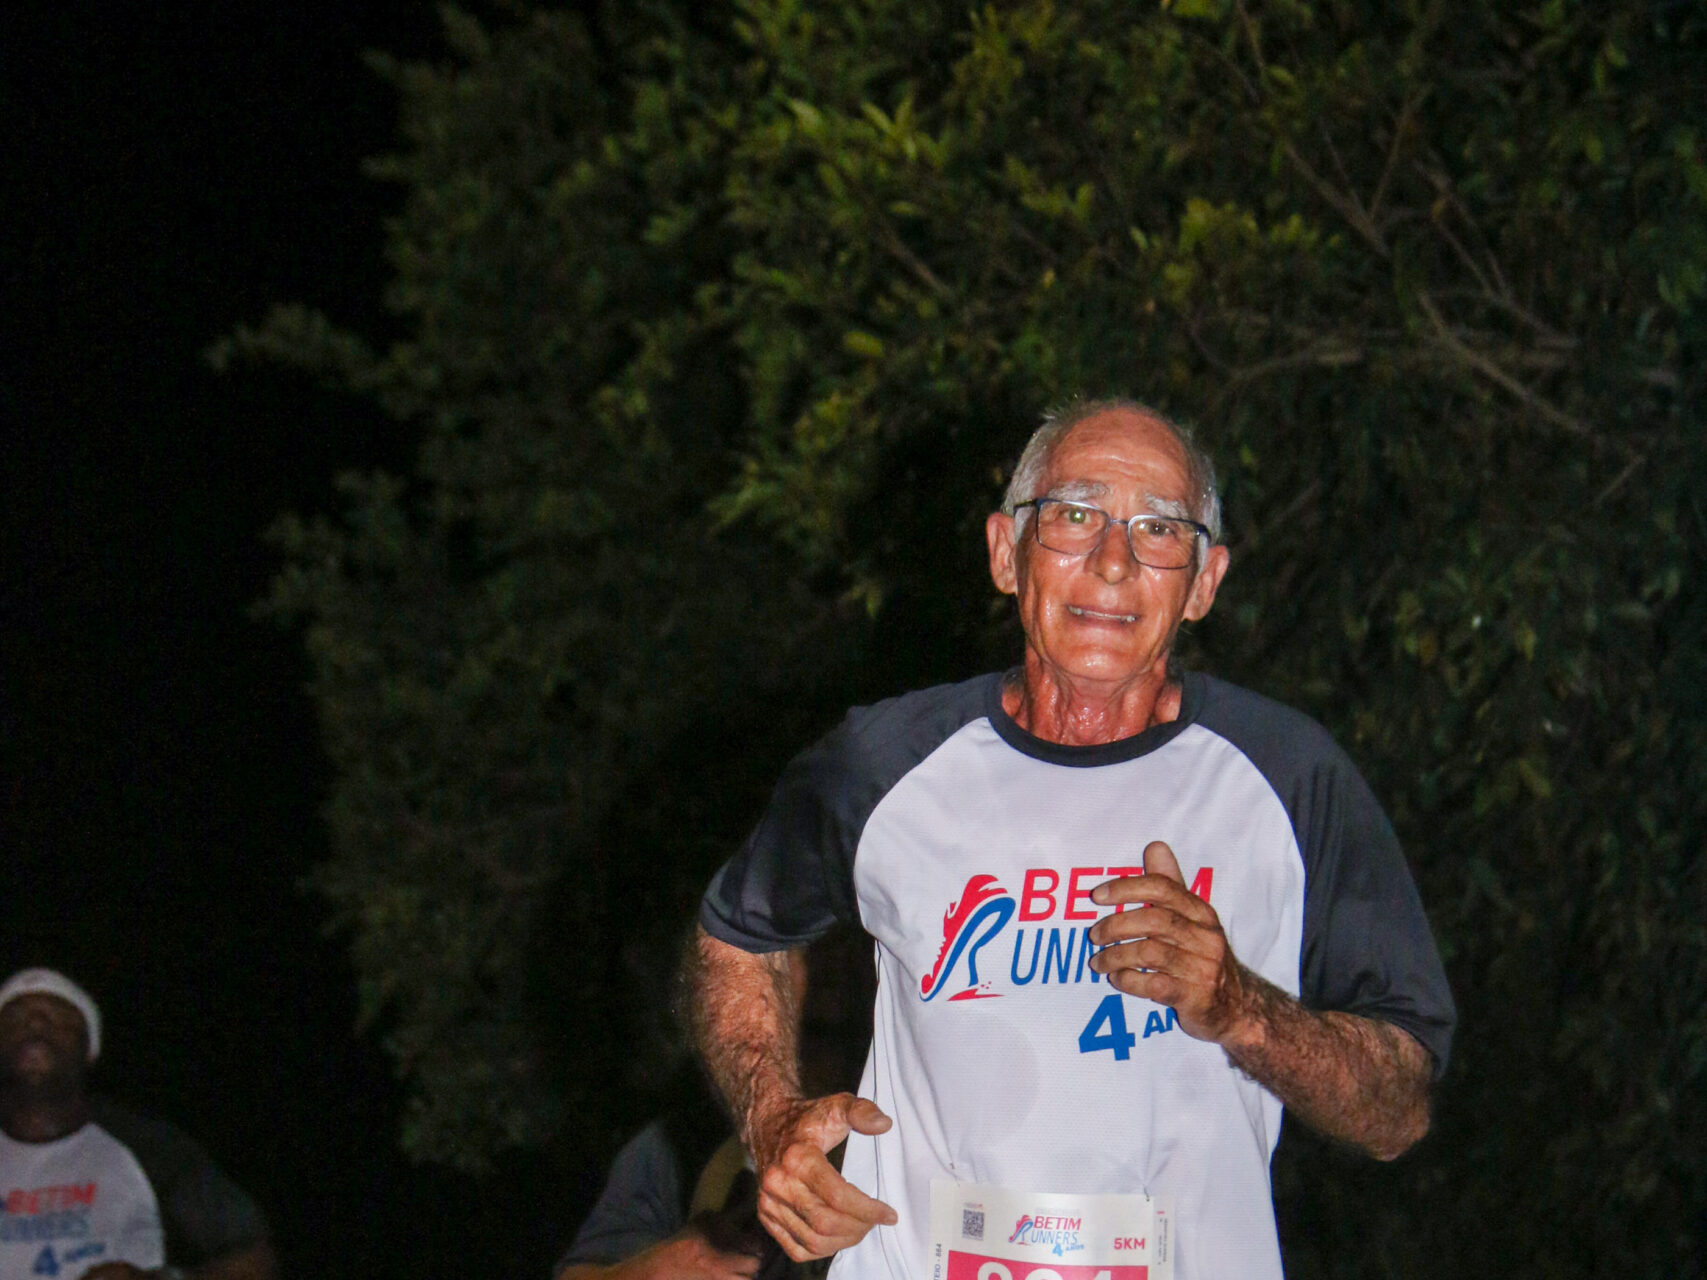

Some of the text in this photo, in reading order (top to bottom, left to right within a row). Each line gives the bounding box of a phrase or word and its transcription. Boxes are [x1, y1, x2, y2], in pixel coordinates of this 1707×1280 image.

[1078, 993, 1136, 1062] 4
[1033, 1215, 1082, 1231] BETIM
[1052, 1243, 1064, 1257] 4
[1113, 1237, 1146, 1251] 5KM
